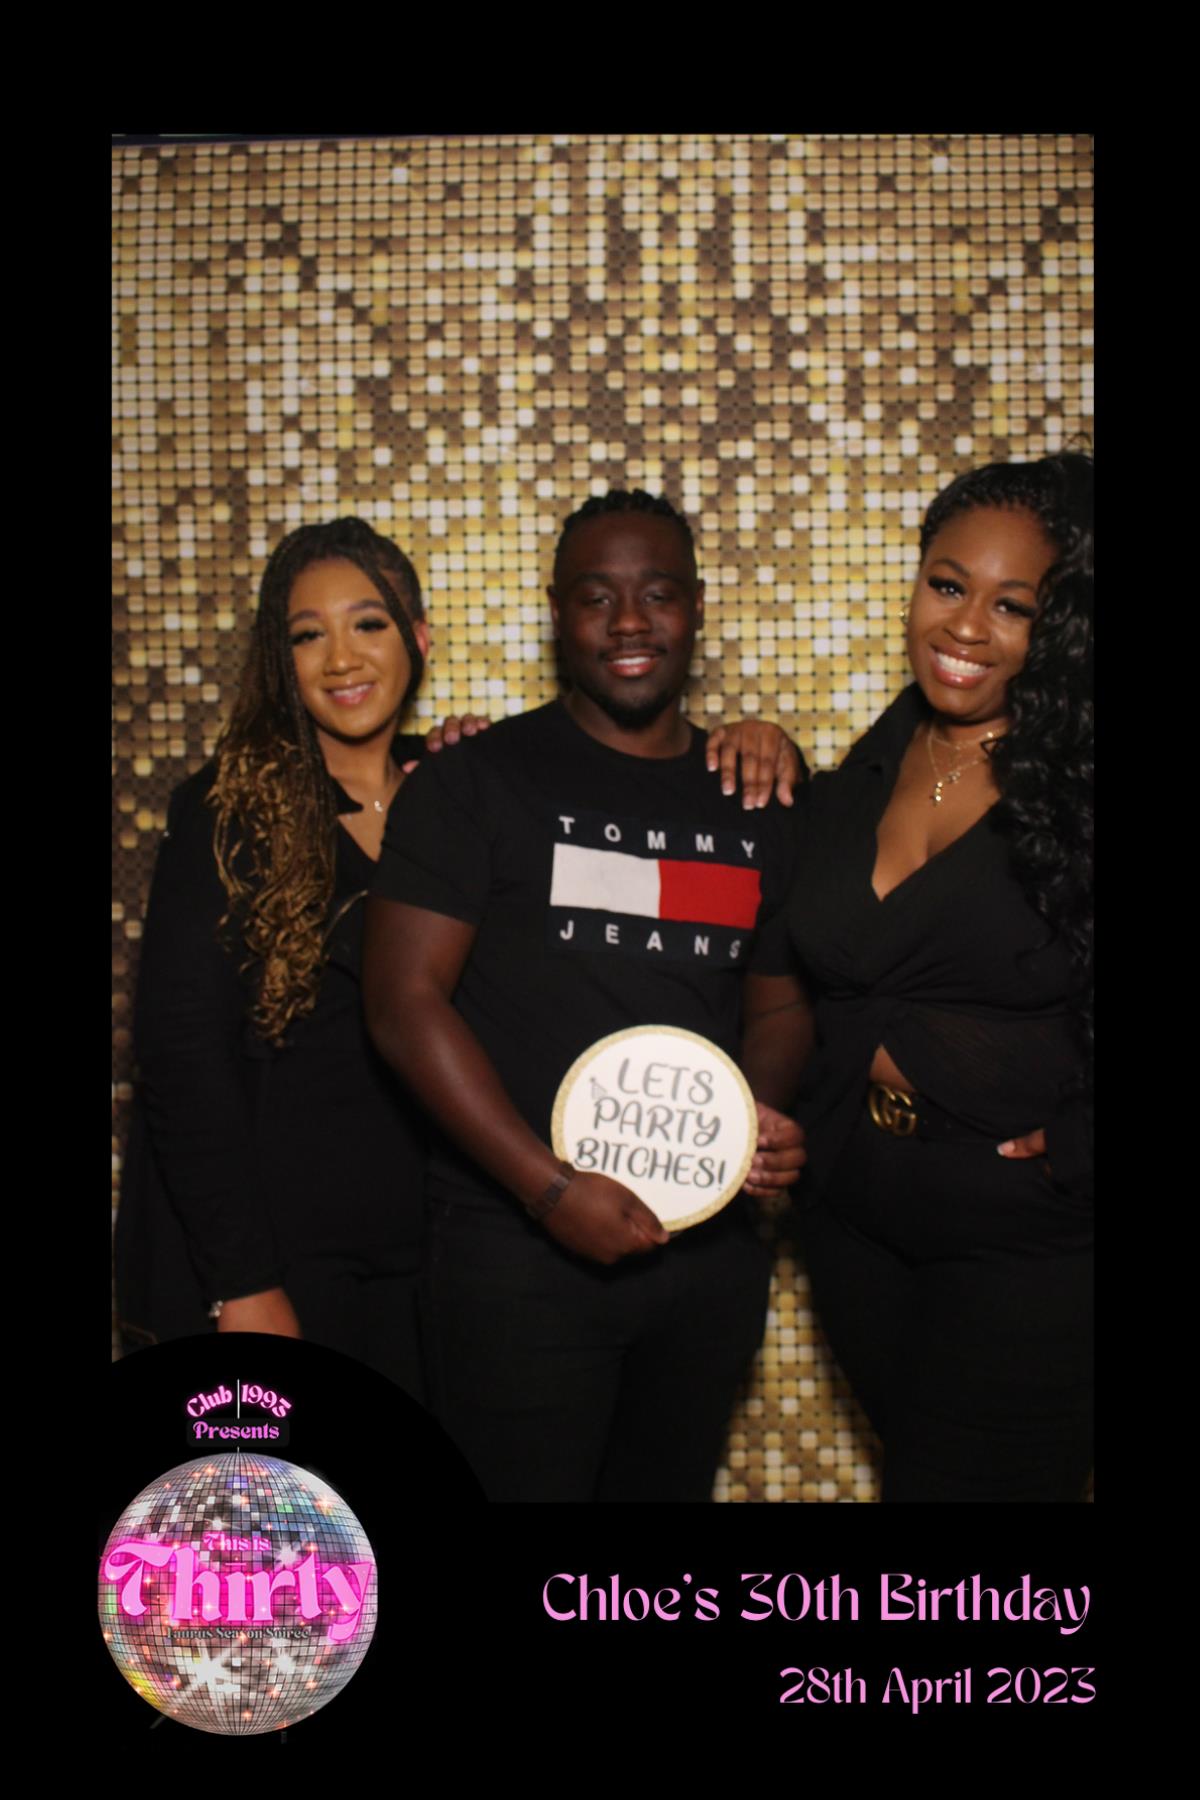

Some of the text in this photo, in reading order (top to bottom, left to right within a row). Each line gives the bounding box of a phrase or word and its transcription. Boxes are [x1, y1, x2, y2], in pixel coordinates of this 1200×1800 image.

[559, 815, 755, 858] TOMMY
[559, 920, 741, 959] JEANS
[617, 1057, 714, 1106] LETS
[592, 1096, 721, 1148] PARTY
[574, 1137, 727, 1191] BITCHES!
